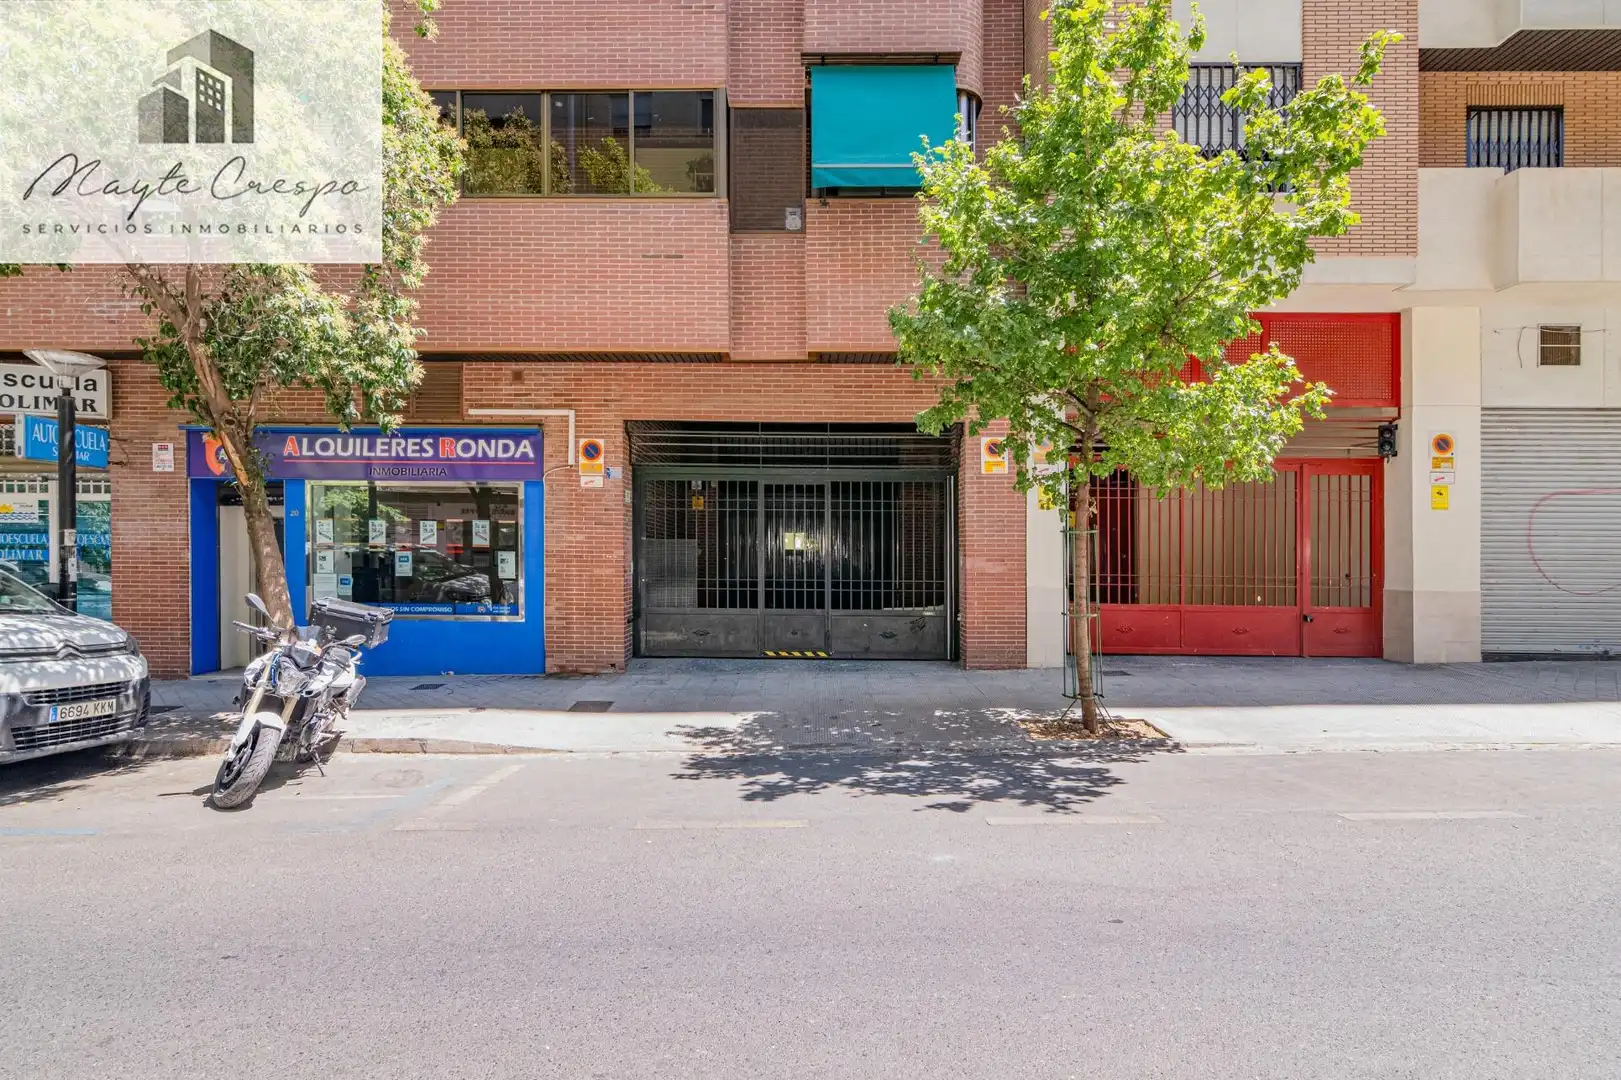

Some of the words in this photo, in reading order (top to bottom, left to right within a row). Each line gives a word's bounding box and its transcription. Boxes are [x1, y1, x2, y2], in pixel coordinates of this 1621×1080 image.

[3, 373, 98, 392] scula
[0, 393, 98, 413] OLIMR
[283, 435, 434, 457] ALQUILERES
[439, 437, 535, 458] RONDA
[369, 467, 448, 477] INMOBILIARIA
[60, 704, 90, 719] 6694
[93, 701, 115, 714] KKM
